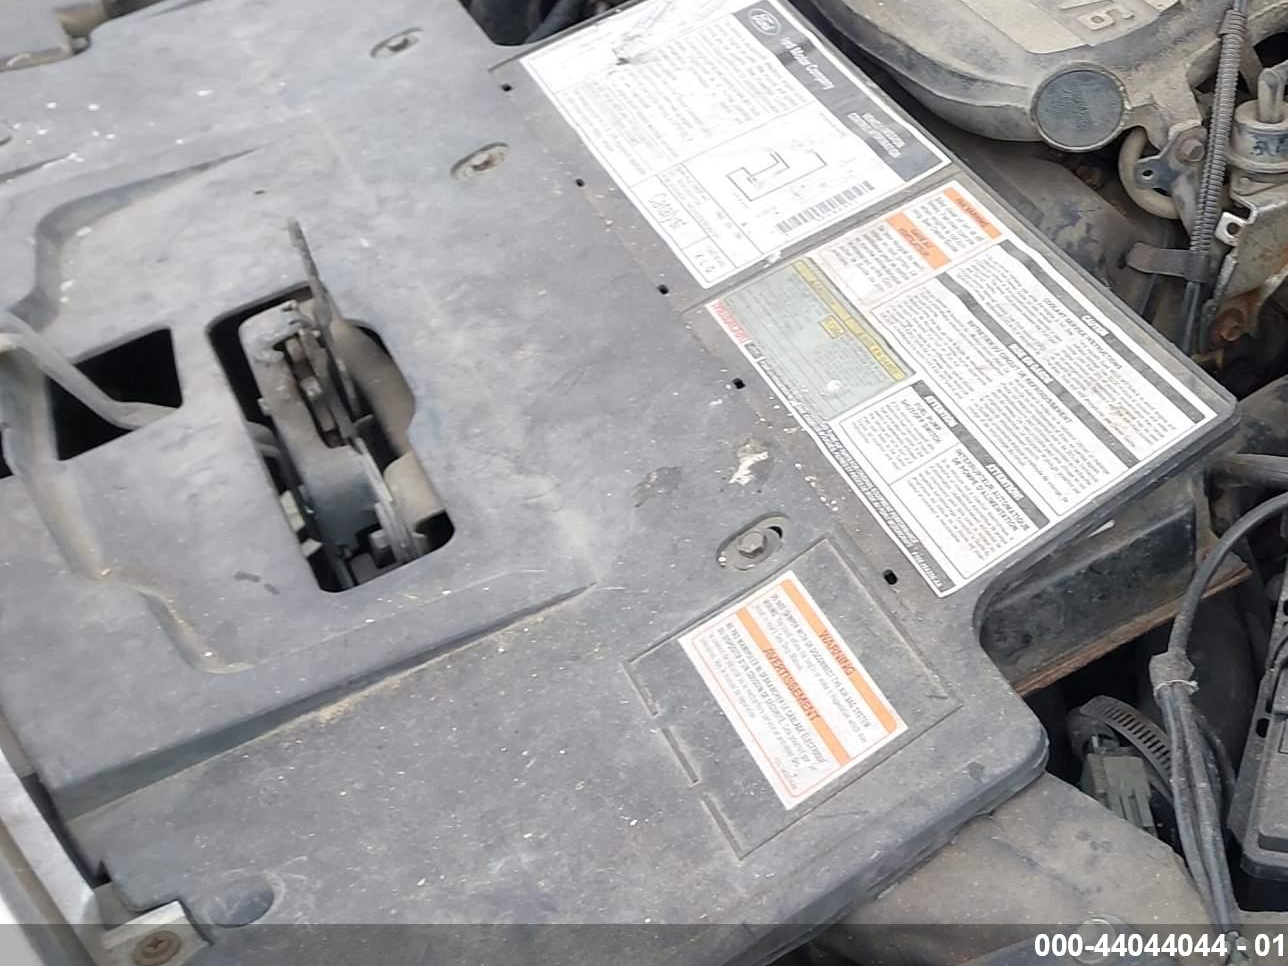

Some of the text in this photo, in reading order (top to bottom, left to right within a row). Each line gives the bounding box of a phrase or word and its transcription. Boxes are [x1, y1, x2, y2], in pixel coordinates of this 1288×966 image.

[787, 45, 816, 67] Motor
[801, 62, 839, 92] Company
[1079, 312, 1111, 338] CAUTION
[816, 628, 857, 677] WARNING
[761, 644, 821, 723] AVERTISSEMENT
